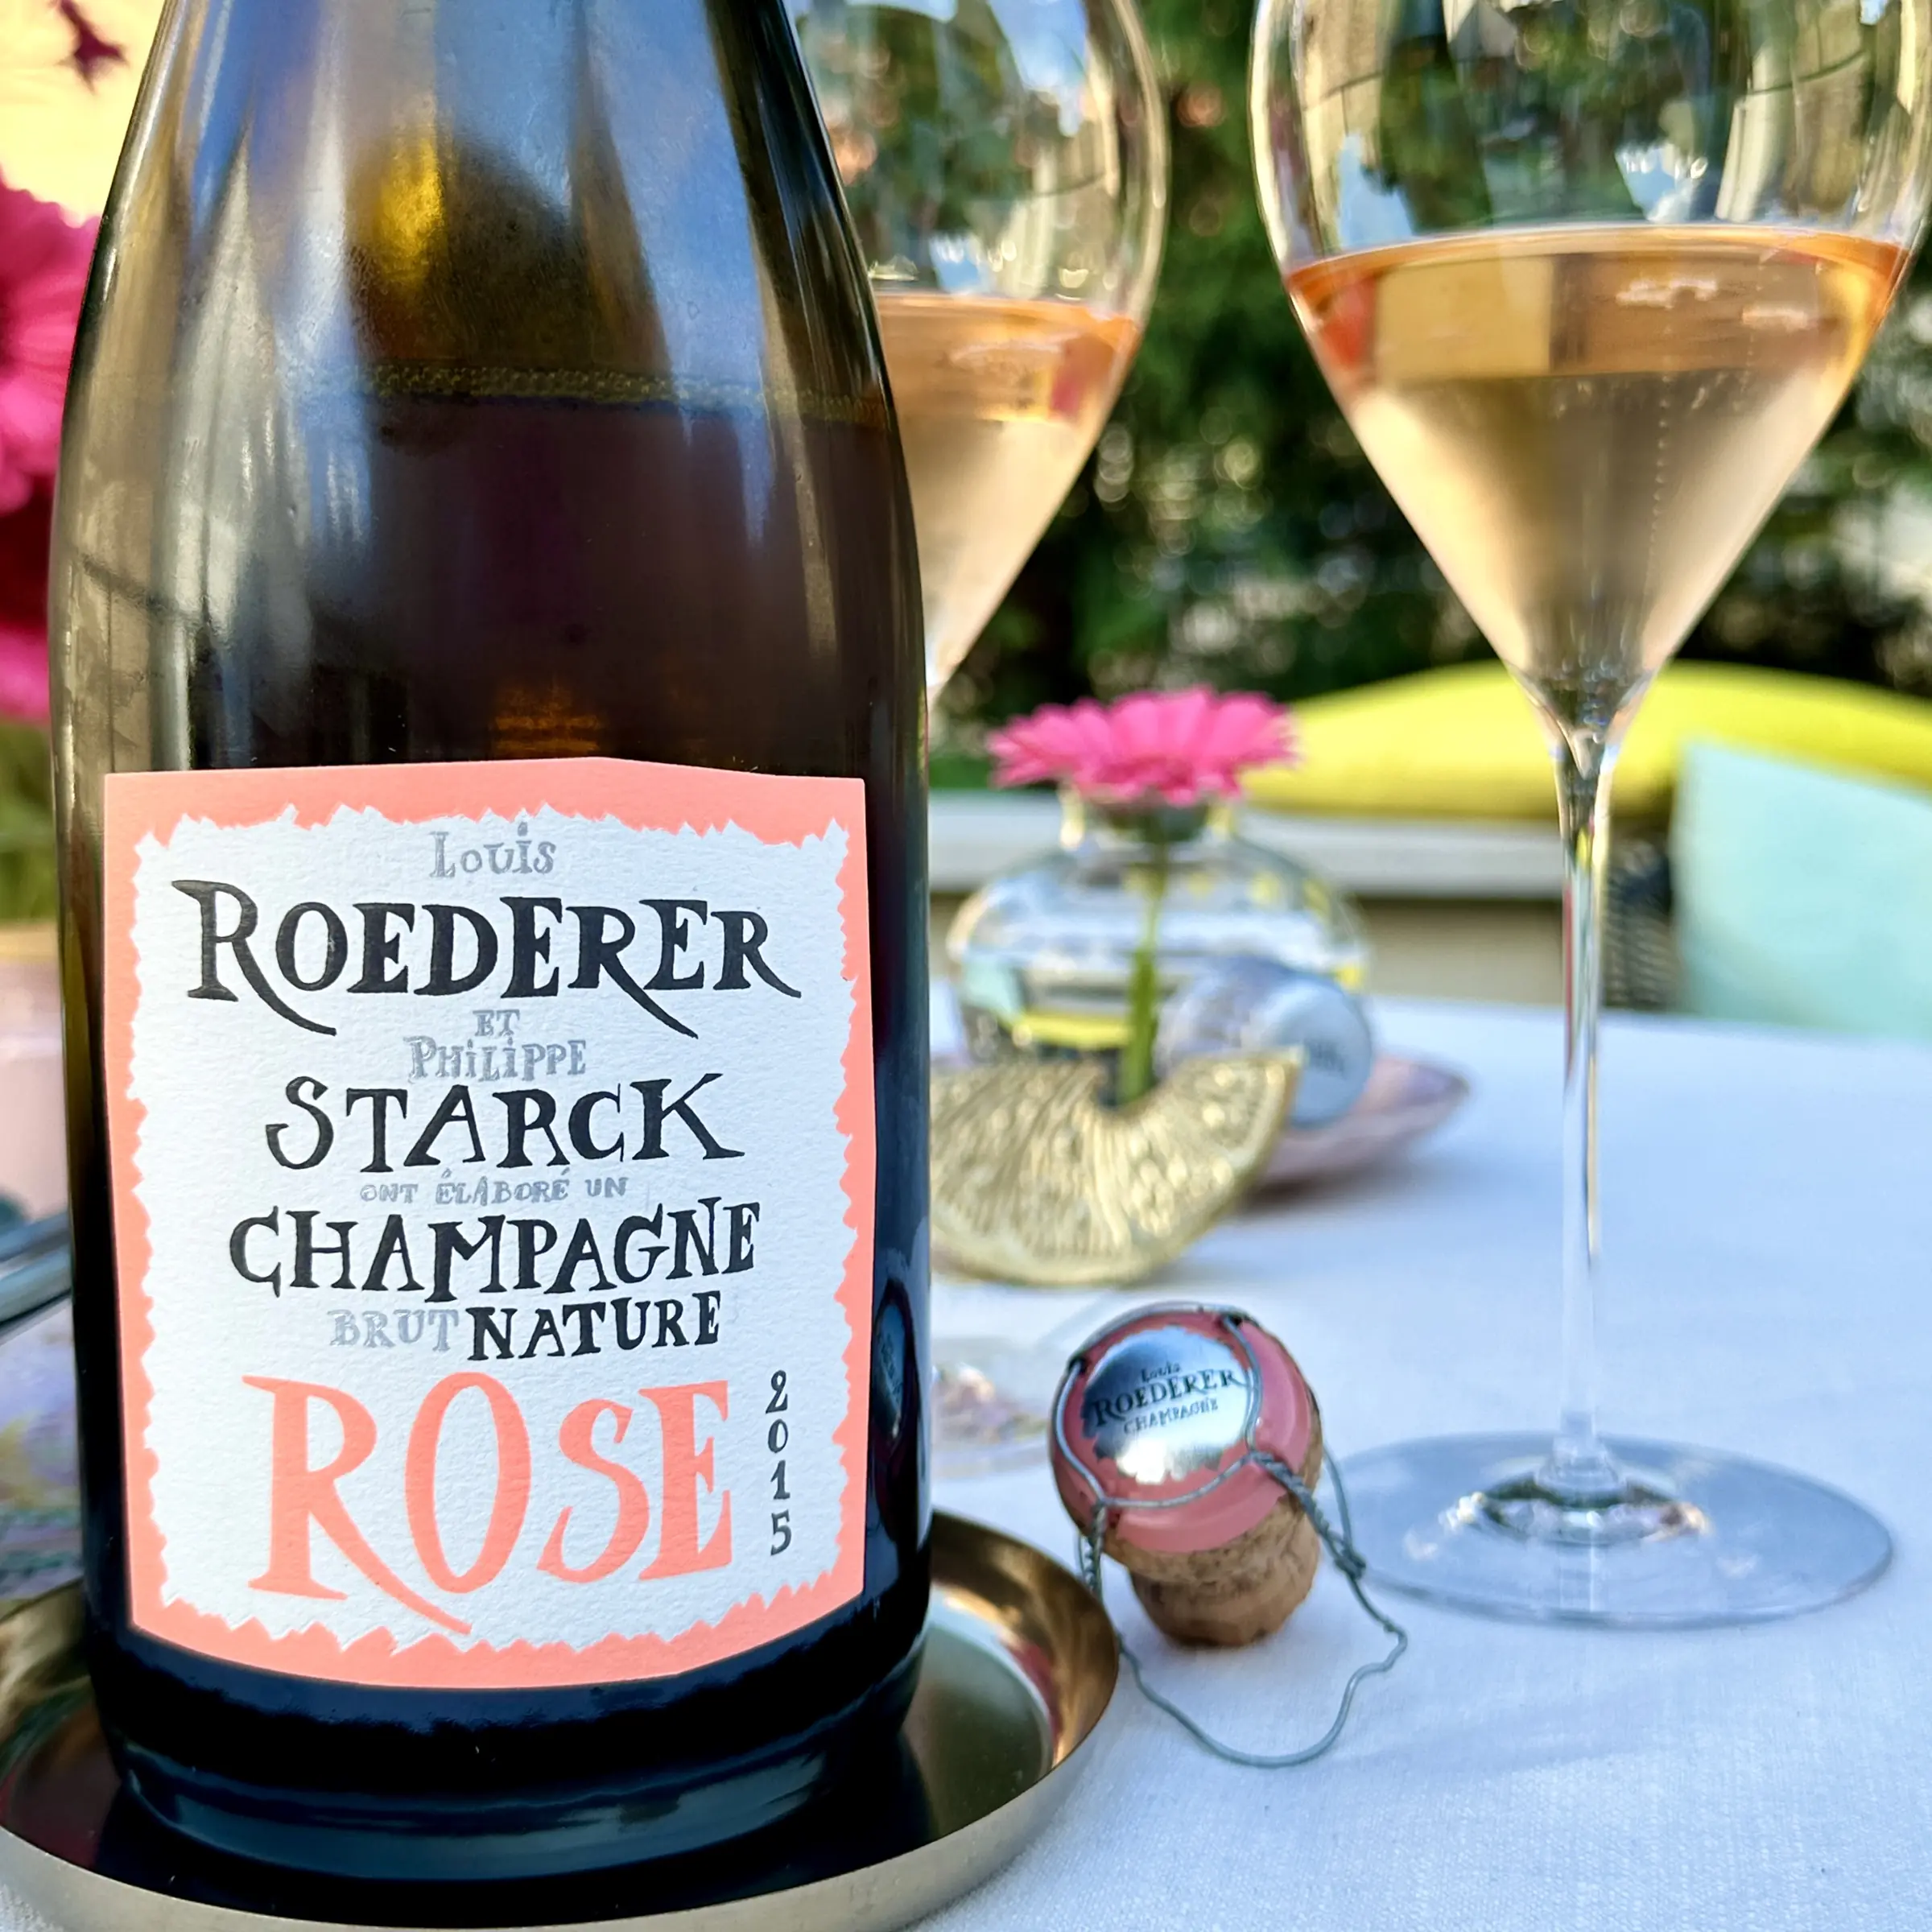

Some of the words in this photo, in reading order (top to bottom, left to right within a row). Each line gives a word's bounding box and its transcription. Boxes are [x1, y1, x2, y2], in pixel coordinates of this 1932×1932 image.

[428, 822, 557, 879] Louis
[171, 879, 802, 1037] ROEDERER
[472, 1008, 521, 1037] ET
[266, 1072, 745, 1174] STARCK
[359, 1183, 419, 1204] ONT
[435, 1167, 571, 1208] ÉLABORÉ
[584, 1176, 630, 1199] UN
[229, 1195, 761, 1304] CHAMPAGNE
[327, 1308, 460, 1352] BRUT
[466, 1290, 721, 1361] NATURE
[1092, 1368, 1247, 1427] ROEDERER
[1124, 1397, 1219, 1435] CHAMPAGNE
[242, 1371, 733, 1635] ROSE
